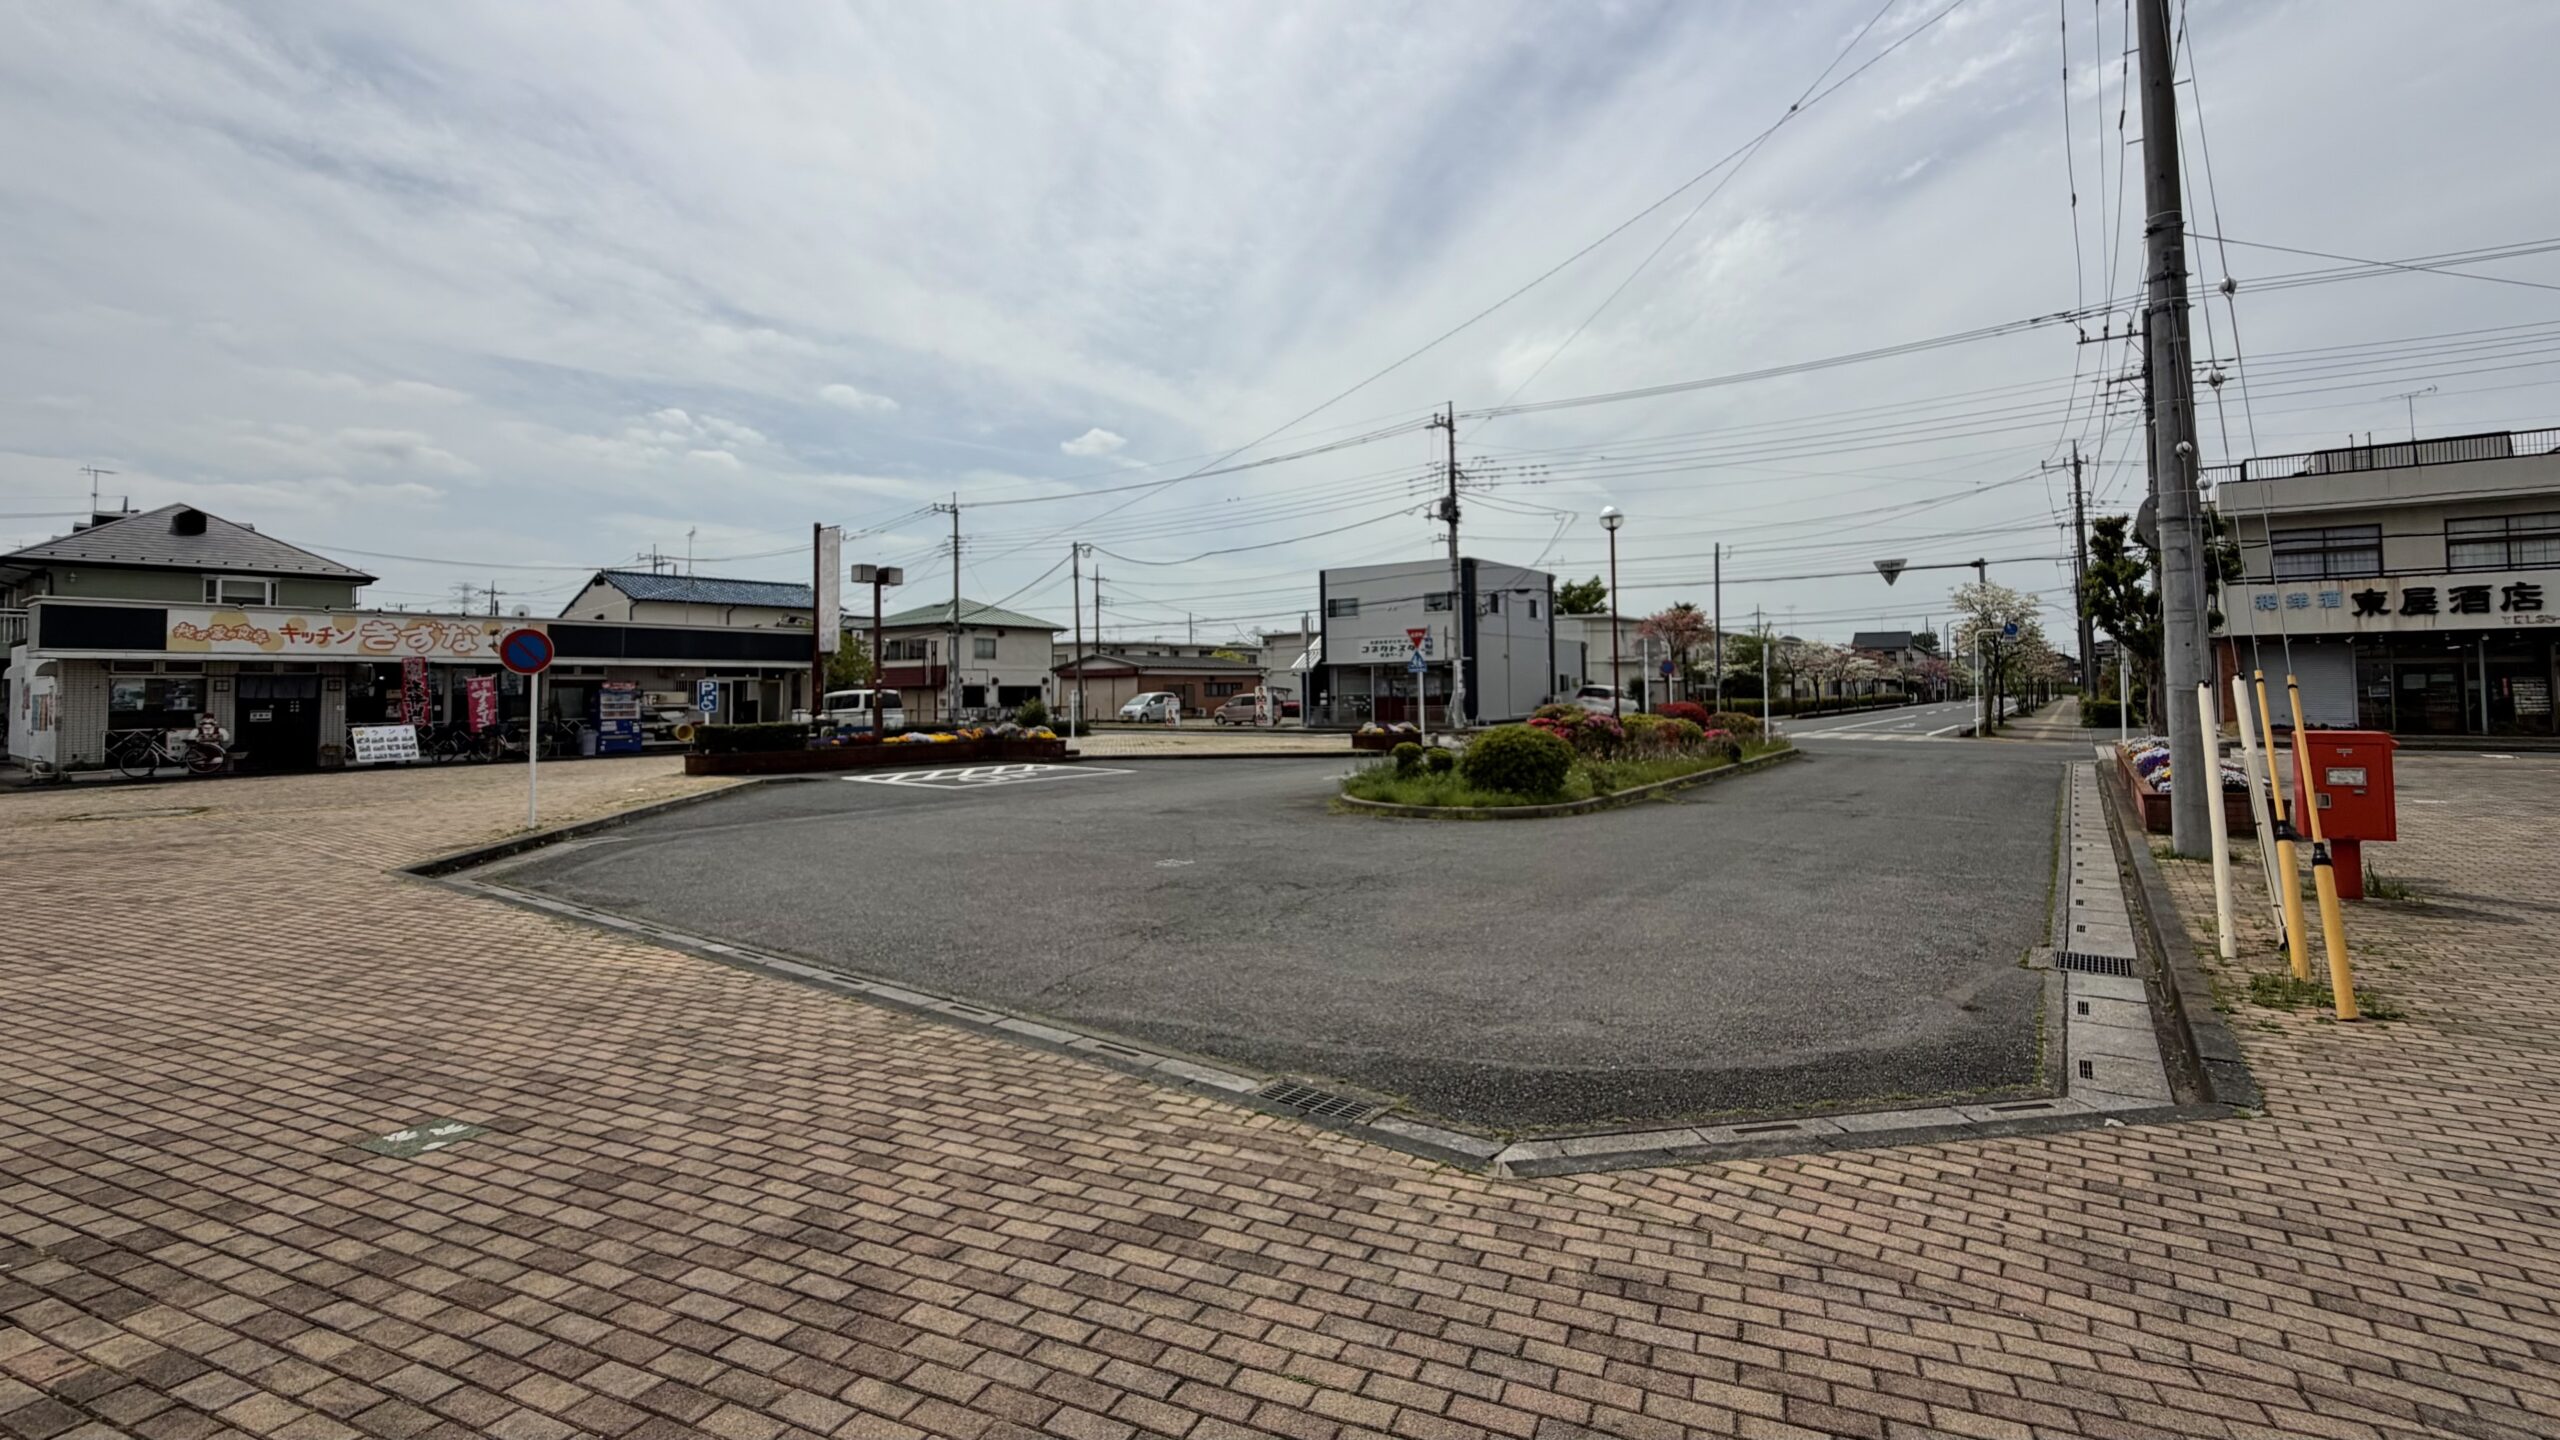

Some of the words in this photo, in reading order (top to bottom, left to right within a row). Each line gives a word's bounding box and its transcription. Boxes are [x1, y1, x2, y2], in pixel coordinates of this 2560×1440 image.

[2351, 581, 2544, 617] 東屋酒店
[172, 621, 272, 645] 我が家の食卓
[278, 623, 356, 644] キッチン
[360, 620, 481, 653] きずな
[701, 682, 714, 695] P
